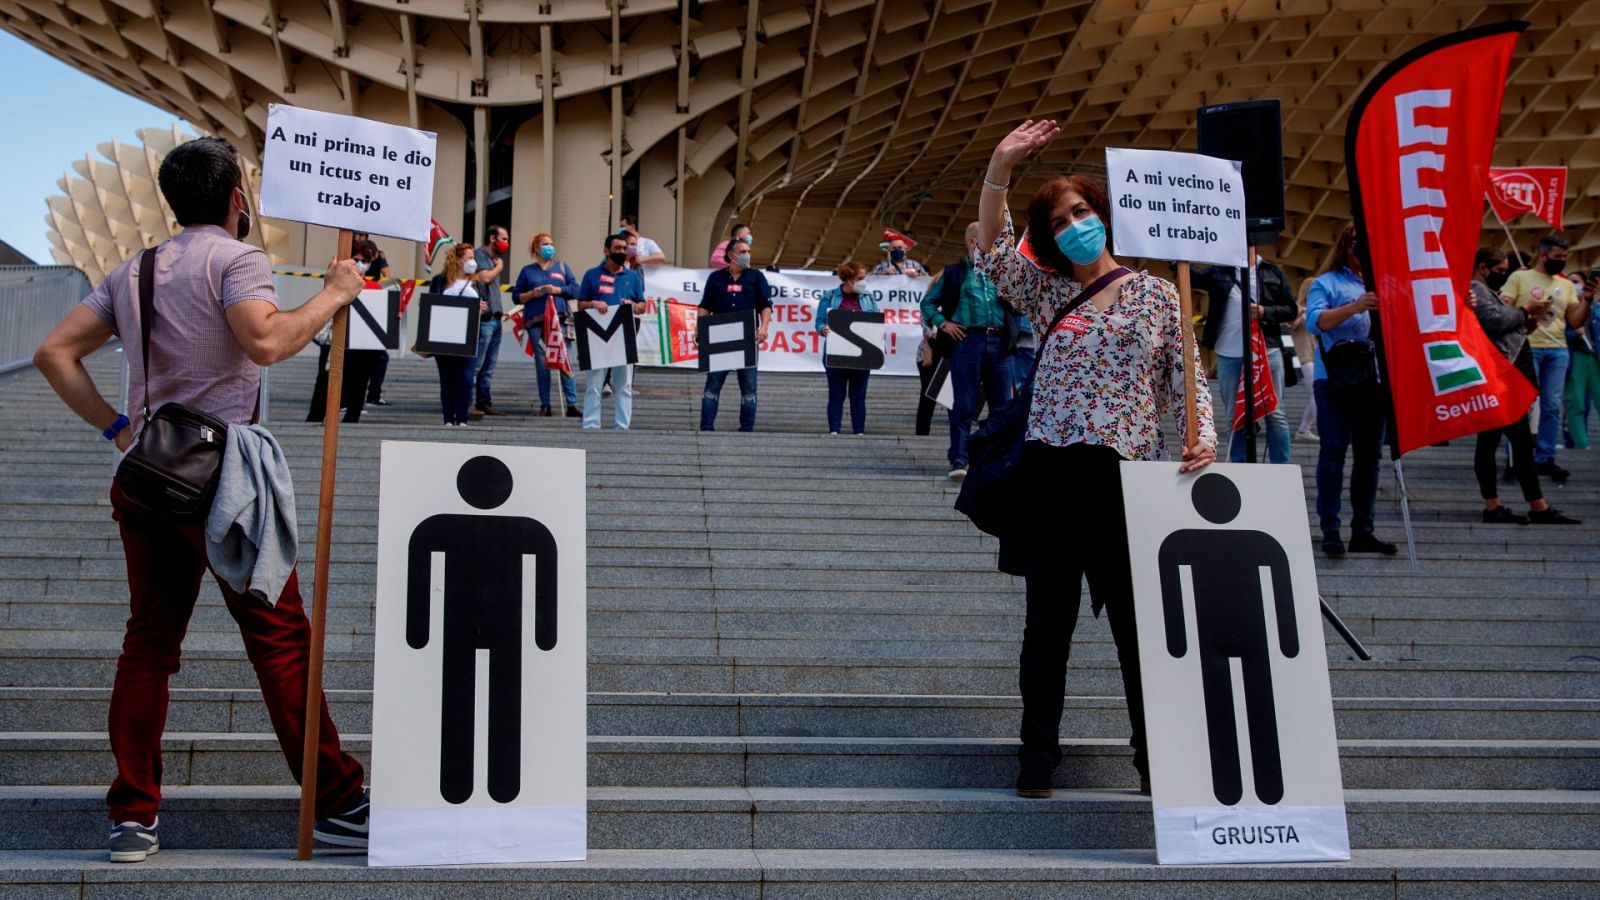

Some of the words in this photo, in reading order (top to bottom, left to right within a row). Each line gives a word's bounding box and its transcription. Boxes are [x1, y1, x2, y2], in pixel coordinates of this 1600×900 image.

[271, 127, 286, 141] A
[294, 132, 317, 147] mi
[325, 138, 375, 157] prima
[383, 146, 397, 161] le
[405, 151, 431, 167] dio
[290, 160, 311, 173] un
[320, 161, 361, 181] ictus
[369, 174, 388, 186] en
[397, 177, 411, 190] el
[1126, 169, 1138, 183] A
[1144, 171, 1162, 185] mi
[1168, 174, 1214, 190] vecino
[1220, 179, 1231, 192] le
[318, 191, 380, 212] trabajo
[1119, 194, 1142, 209] dio
[1148, 200, 1166, 211] un
[1172, 198, 1220, 216] infarto
[1225, 208, 1240, 219] en
[1394, 89, 1456, 334] CCOO
[1148, 224, 1160, 237] el
[1167, 226, 1217, 243] trabajo
[683, 281, 700, 292] EL
[769, 285, 788, 298] DE
[889, 290, 923, 303] PRIV
[769, 304, 812, 322] TES
[884, 308, 922, 325] RES
[758, 330, 820, 353] AST
[1436, 394, 1500, 421] Sevilla
[1212, 825, 1300, 845] GRUISTA
